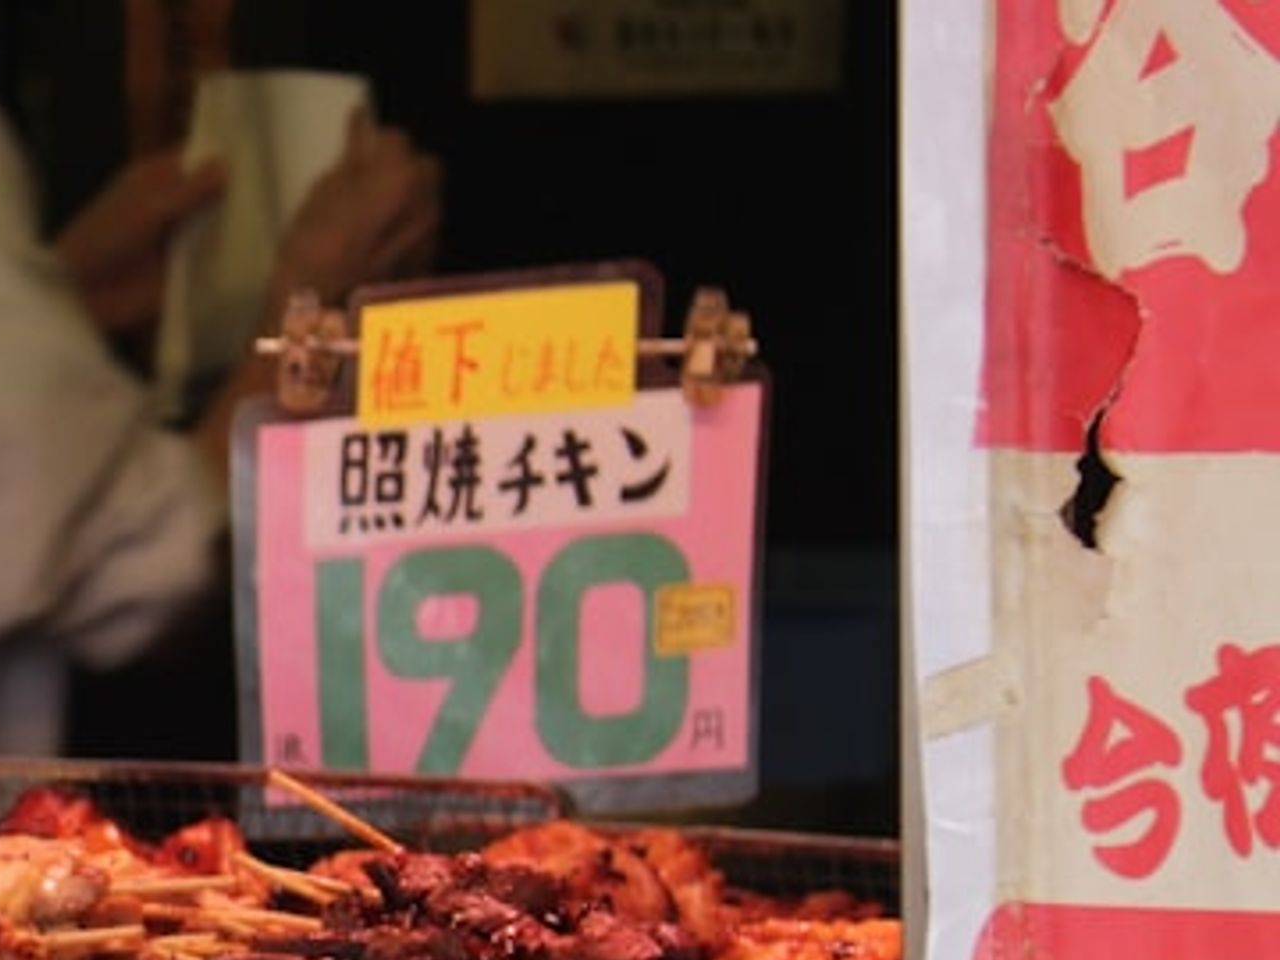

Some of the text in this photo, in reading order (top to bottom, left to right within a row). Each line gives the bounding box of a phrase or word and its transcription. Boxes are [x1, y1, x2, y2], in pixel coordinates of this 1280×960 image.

[339, 424, 671, 534] 照焼チキン
[313, 531, 692, 777] 190
